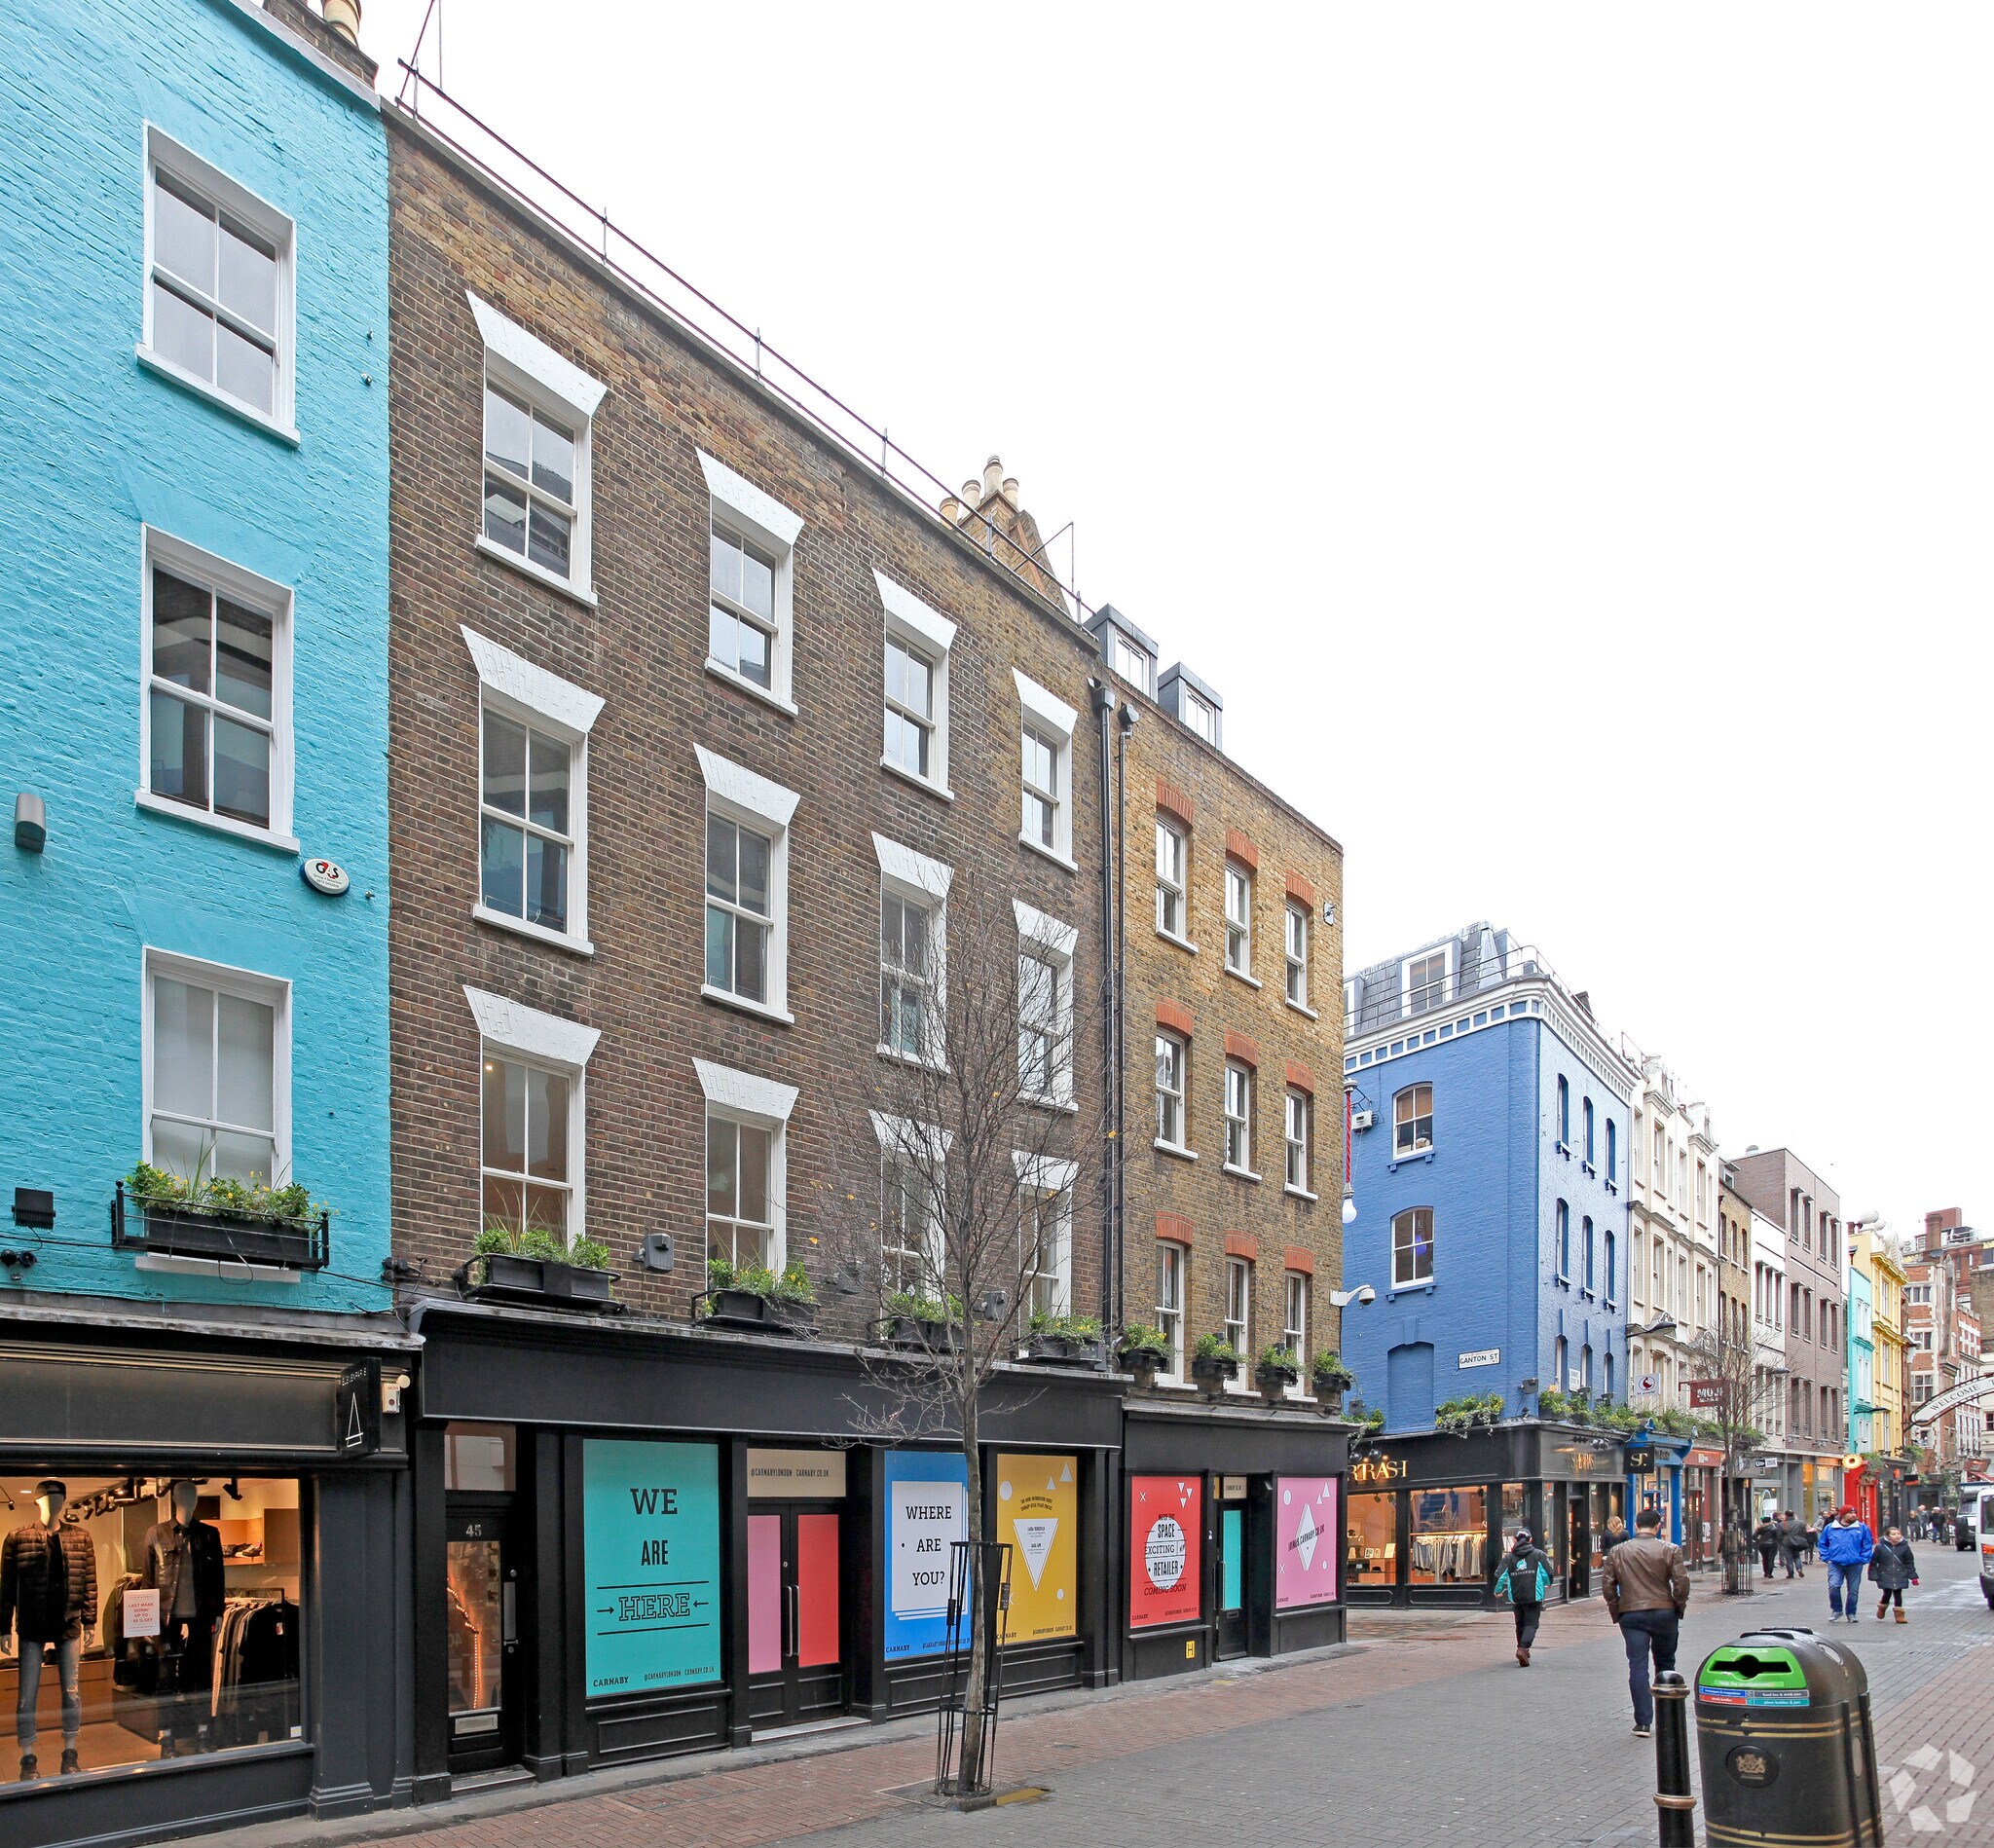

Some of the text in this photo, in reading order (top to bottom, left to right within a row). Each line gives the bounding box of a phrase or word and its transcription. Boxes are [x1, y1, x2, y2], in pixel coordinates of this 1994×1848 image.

[1459, 1354, 1487, 1364] GANTON
[1696, 1386, 1723, 1398] MUJI
[1930, 1384, 1980, 1411] WELCOME
[1348, 1460, 1409, 1482] RTRASH
[630, 1488, 678, 1515] WE
[905, 1506, 952, 1519] WHERE
[466, 1524, 482, 1537] 45
[1157, 1523, 1175, 1538] SPACE
[917, 1538, 941, 1552] ARE
[1145, 1544, 1175, 1555] EXCITING
[641, 1540, 668, 1566] ARE
[1153, 1560, 1179, 1576] RETAILER
[912, 1571, 945, 1586] YOU?
[1144, 1584, 1187, 1596] COMING SOON
[619, 1592, 690, 1622] HERE
[886, 1644, 910, 1653] CARNABY
[593, 1676, 629, 1687] CARNABY
